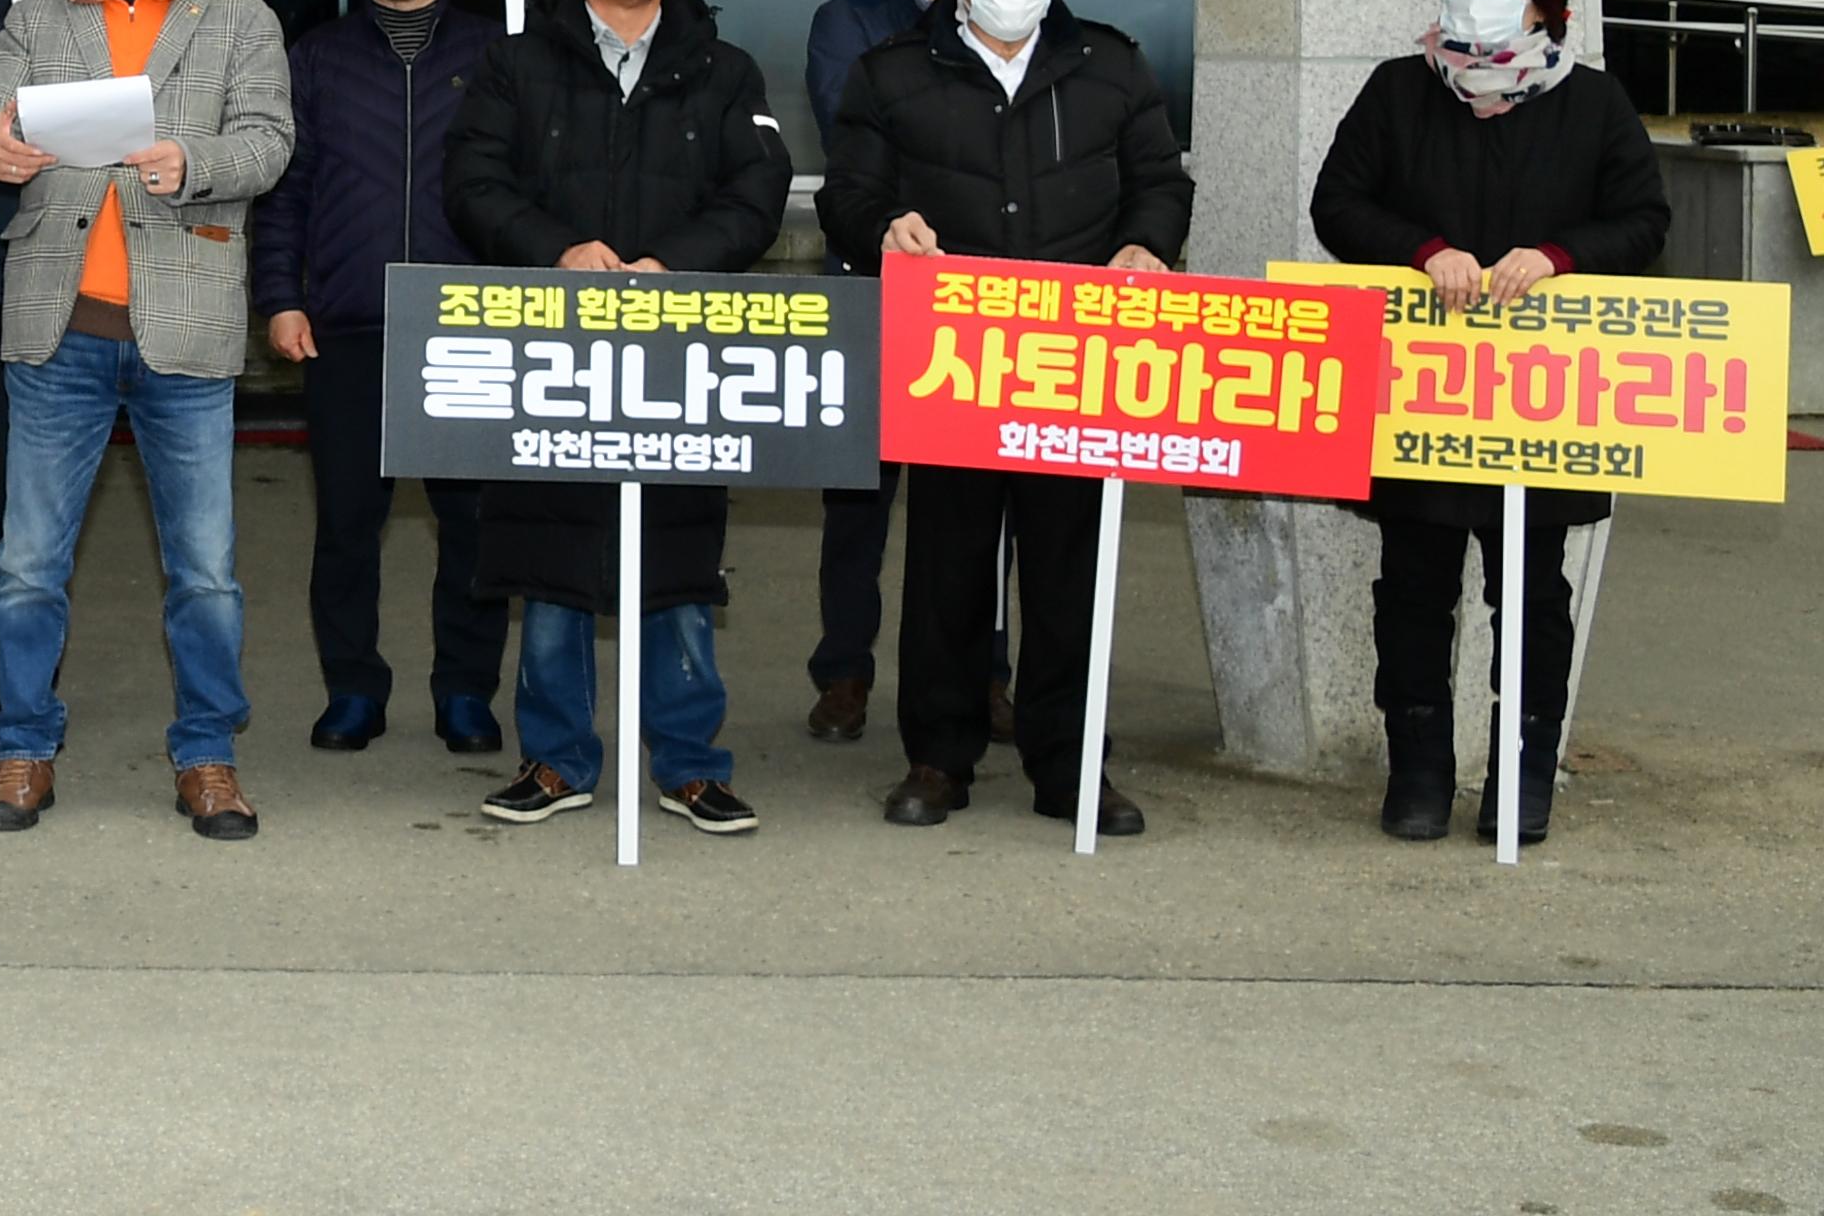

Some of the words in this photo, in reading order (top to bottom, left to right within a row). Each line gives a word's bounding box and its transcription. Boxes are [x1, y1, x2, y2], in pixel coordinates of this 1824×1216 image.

[441, 284, 565, 329] 조명래
[577, 287, 830, 336] 환경부장관은
[932, 272, 1062, 322] 조명래
[1072, 281, 1330, 343] 환경부장관은
[1464, 291, 1732, 342] 환경부장관은
[421, 336, 845, 427] 물러나라!
[908, 323, 1343, 434] 사퇴하라!
[511, 428, 752, 473] 화천군번영회
[997, 421, 1241, 477] 화천군번영회
[1393, 430, 1644, 479] 화천군번영회
